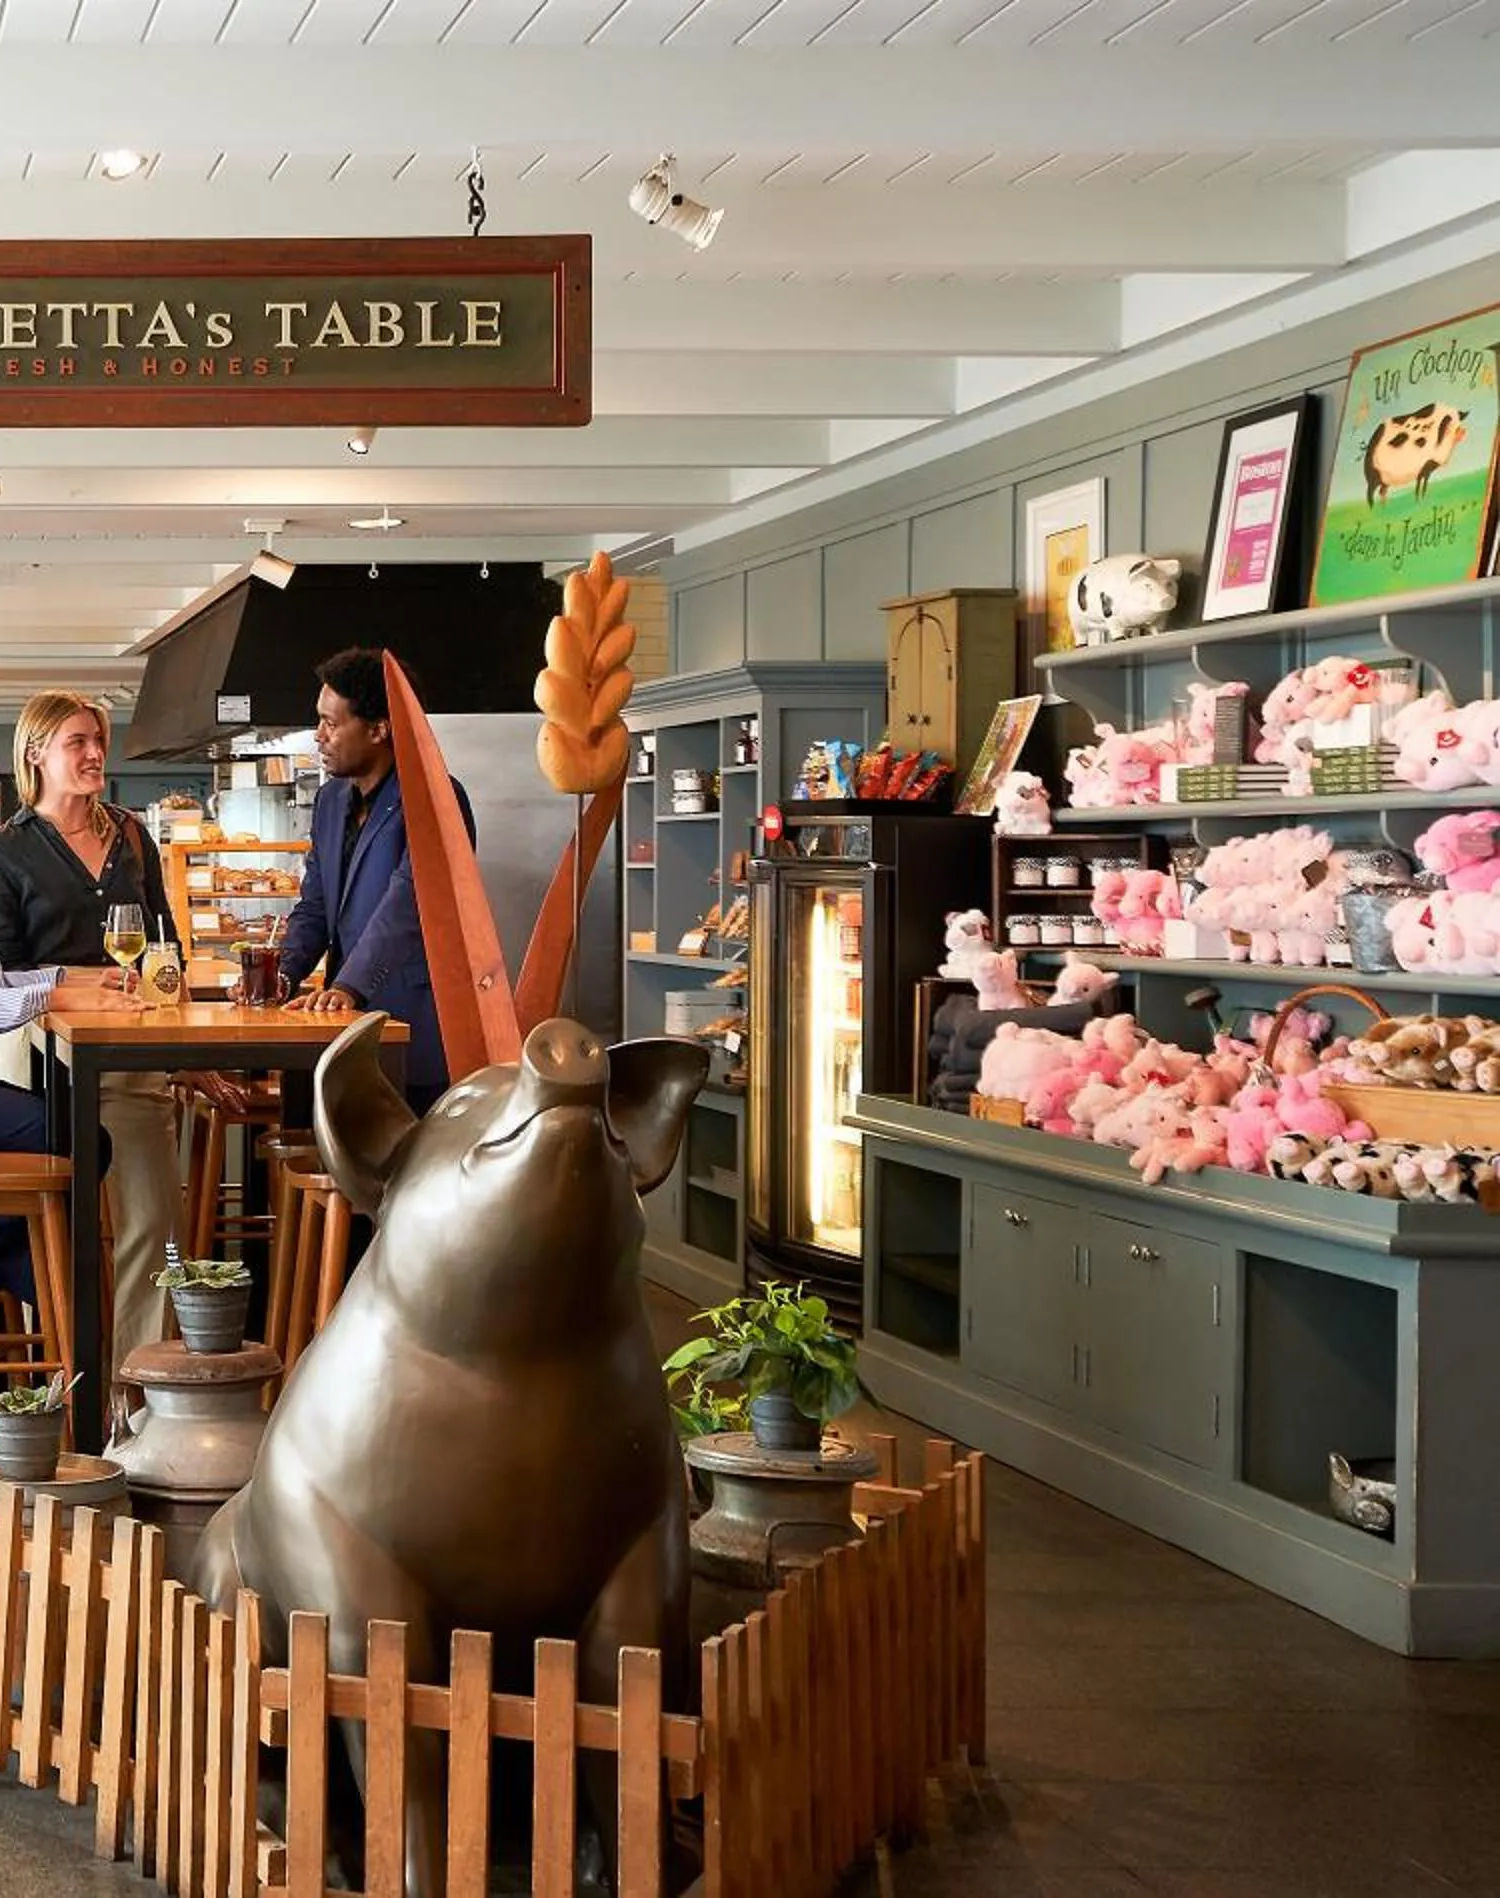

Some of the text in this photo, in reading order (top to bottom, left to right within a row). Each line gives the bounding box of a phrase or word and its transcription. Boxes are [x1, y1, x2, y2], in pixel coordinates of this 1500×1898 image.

[265, 301, 501, 347] TABLE
[103, 358, 118, 376] &
[141, 357, 296, 376] HONEST
[1409, 339, 1485, 390] Cochon
